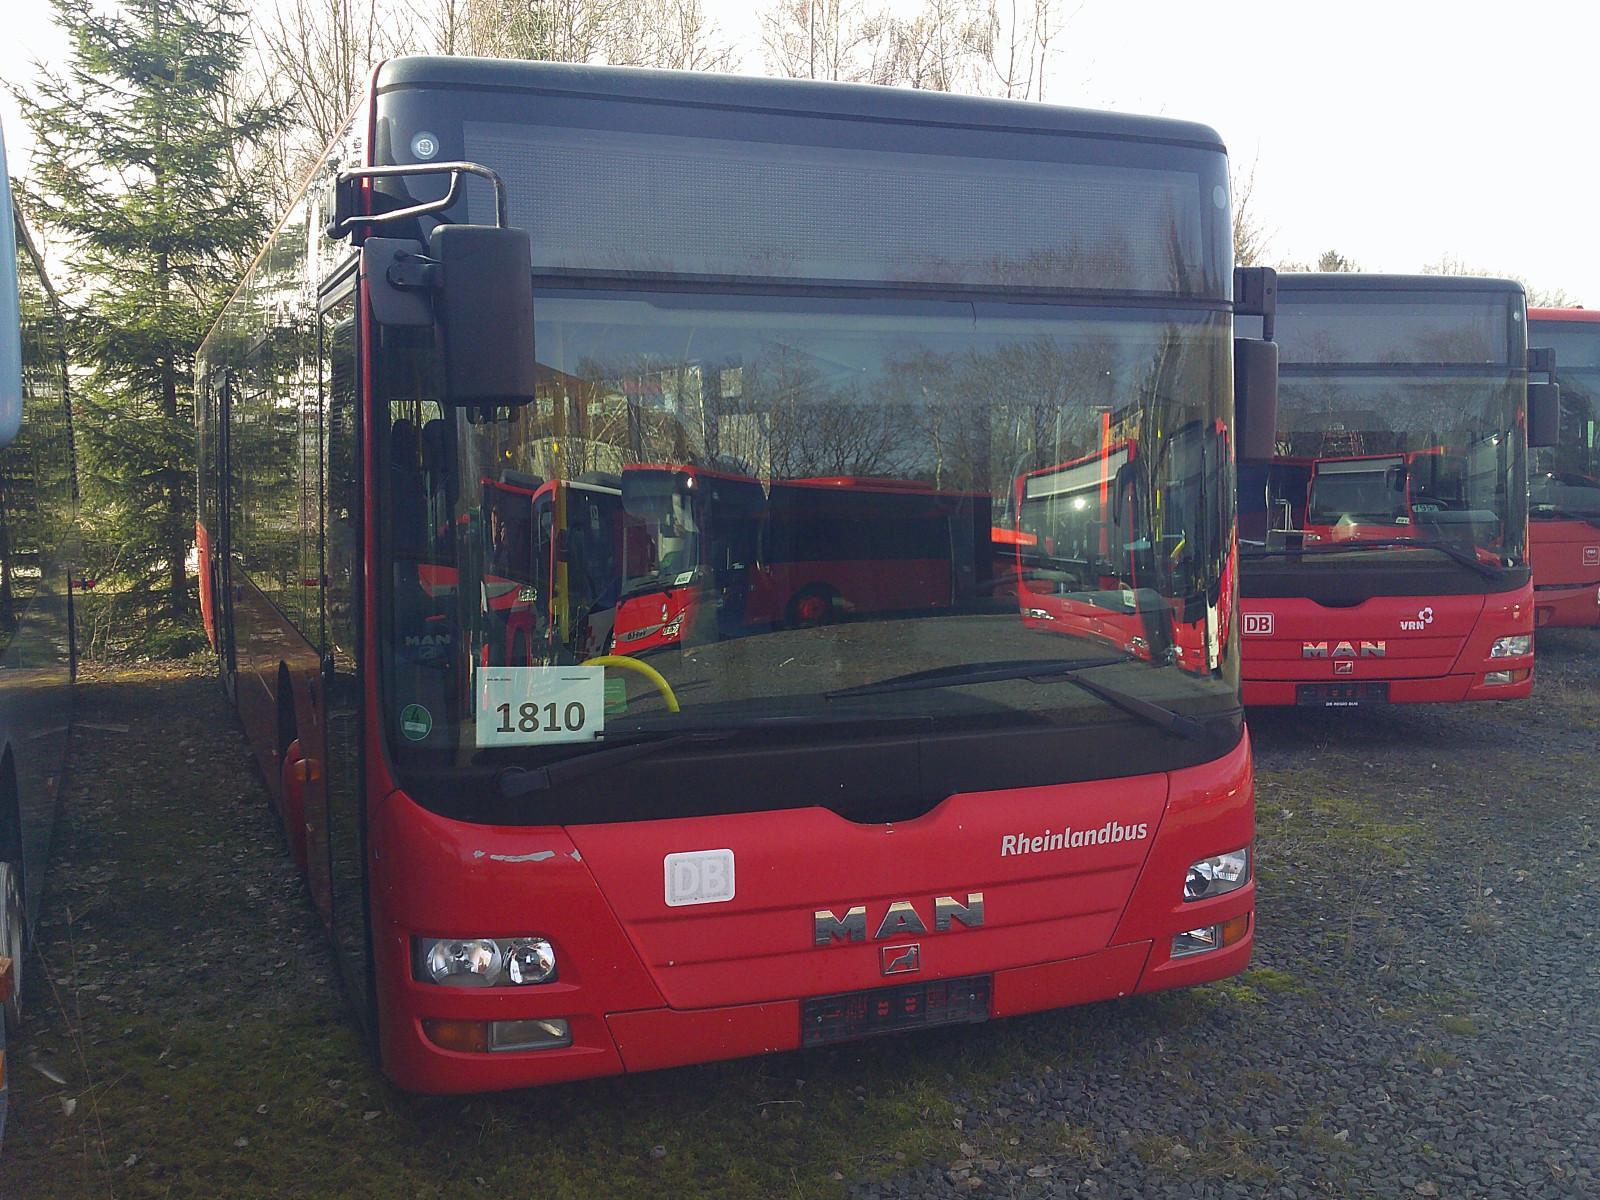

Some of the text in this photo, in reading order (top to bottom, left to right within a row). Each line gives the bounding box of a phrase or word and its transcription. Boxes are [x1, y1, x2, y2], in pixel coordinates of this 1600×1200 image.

[1246, 616, 1270, 632] DB
[1400, 620, 1425, 630] VRN
[1302, 641, 1386, 657] MAN
[496, 701, 586, 733] 1810
[1000, 821, 1148, 857] Rheinlandbus
[674, 860, 725, 897] DB
[813, 893, 984, 945] MAN
